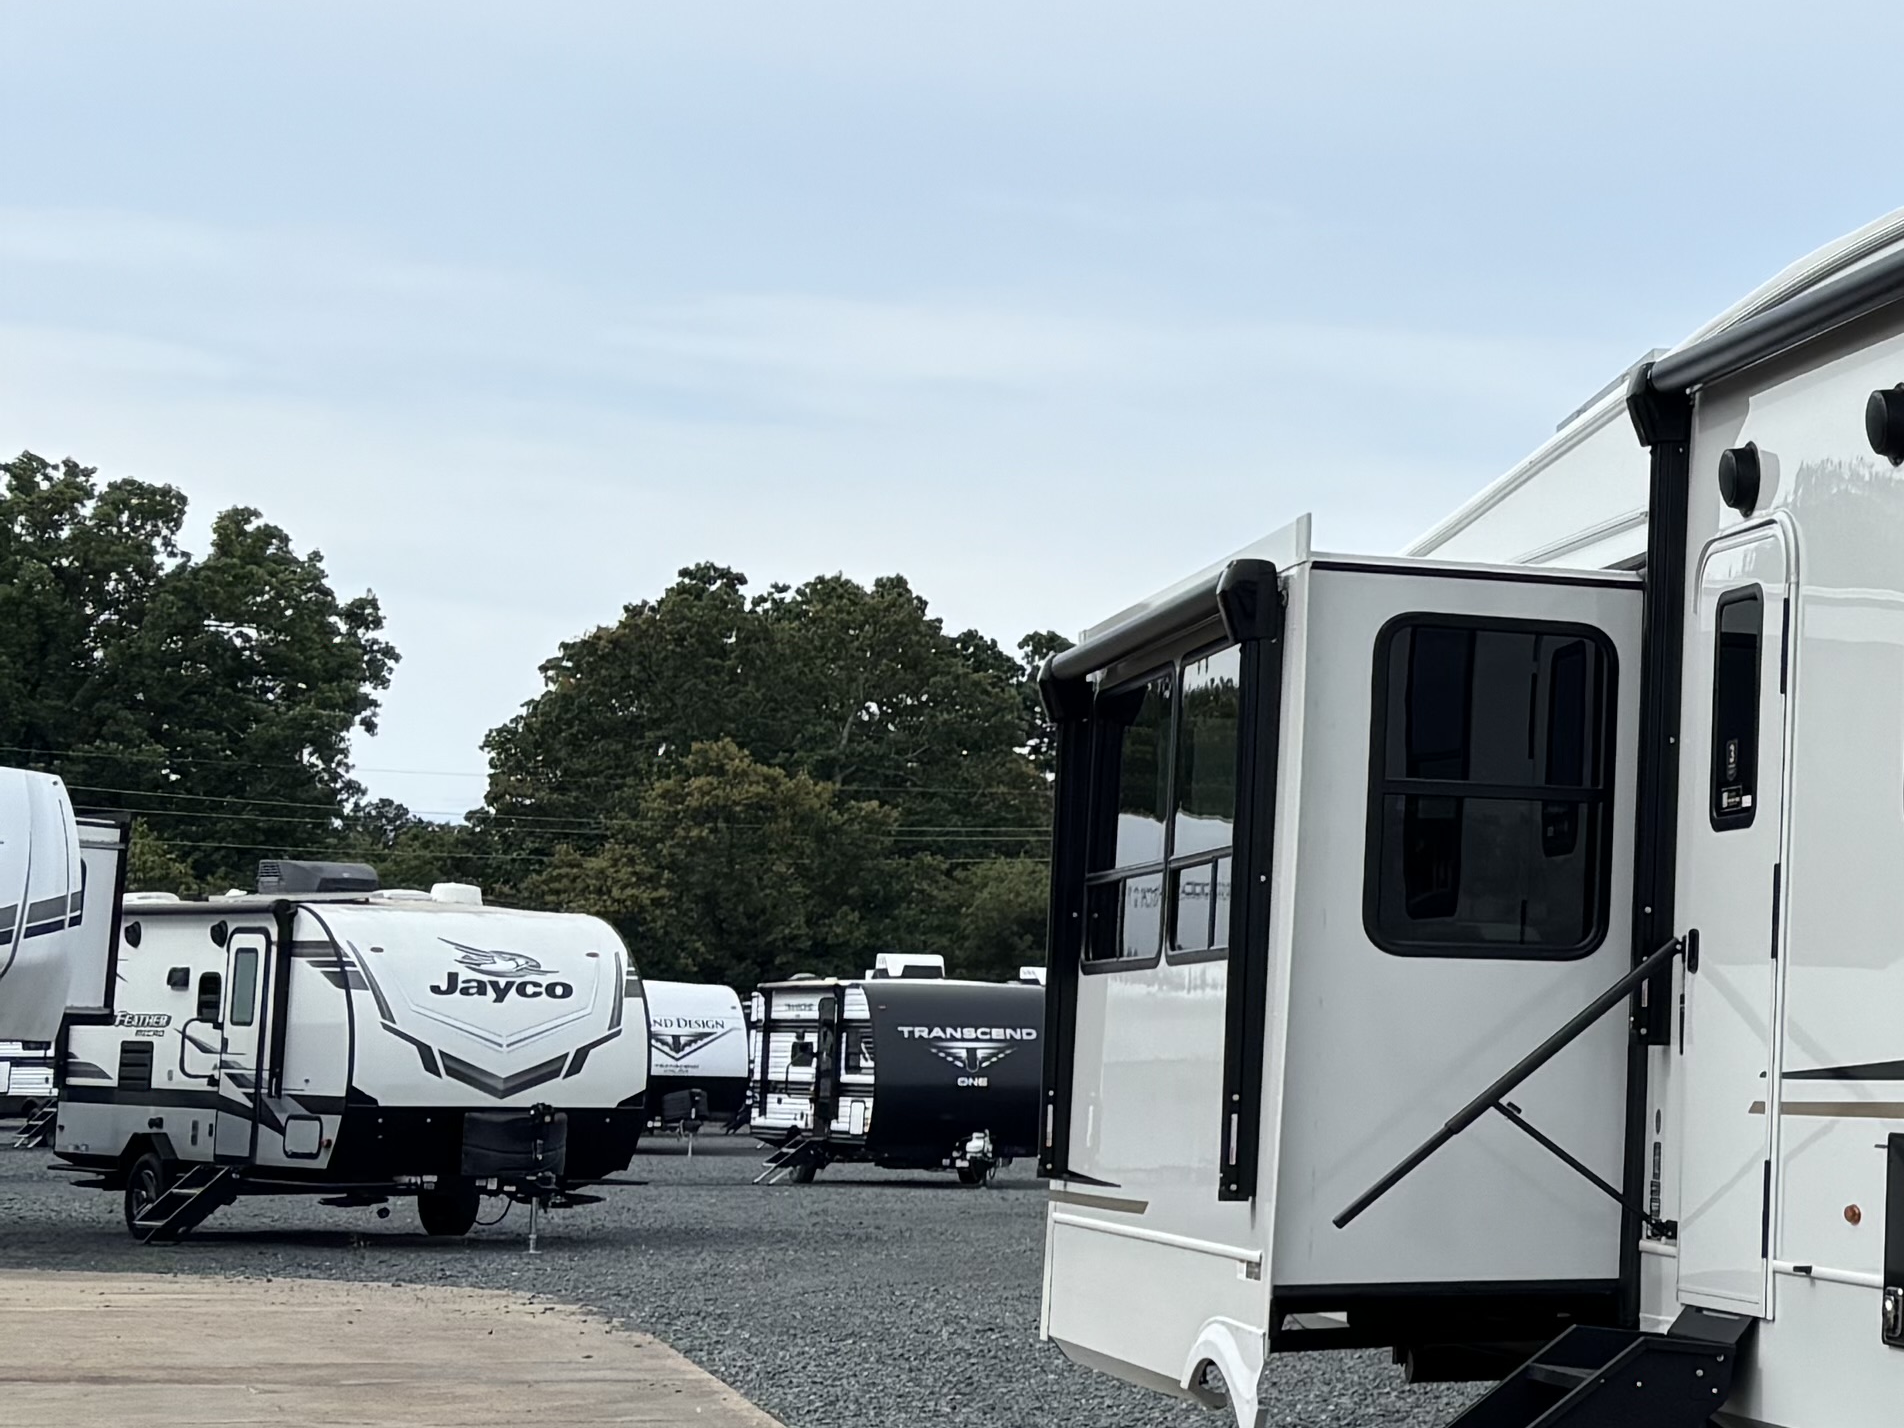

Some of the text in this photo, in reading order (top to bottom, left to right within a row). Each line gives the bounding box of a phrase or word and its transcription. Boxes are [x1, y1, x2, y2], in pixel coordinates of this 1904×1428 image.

[429, 971, 574, 1003] Jayco
[676, 1017, 725, 1029] DESIGN
[897, 1026, 1037, 1040] TRANSCEND
[956, 1076, 988, 1087] ONE
